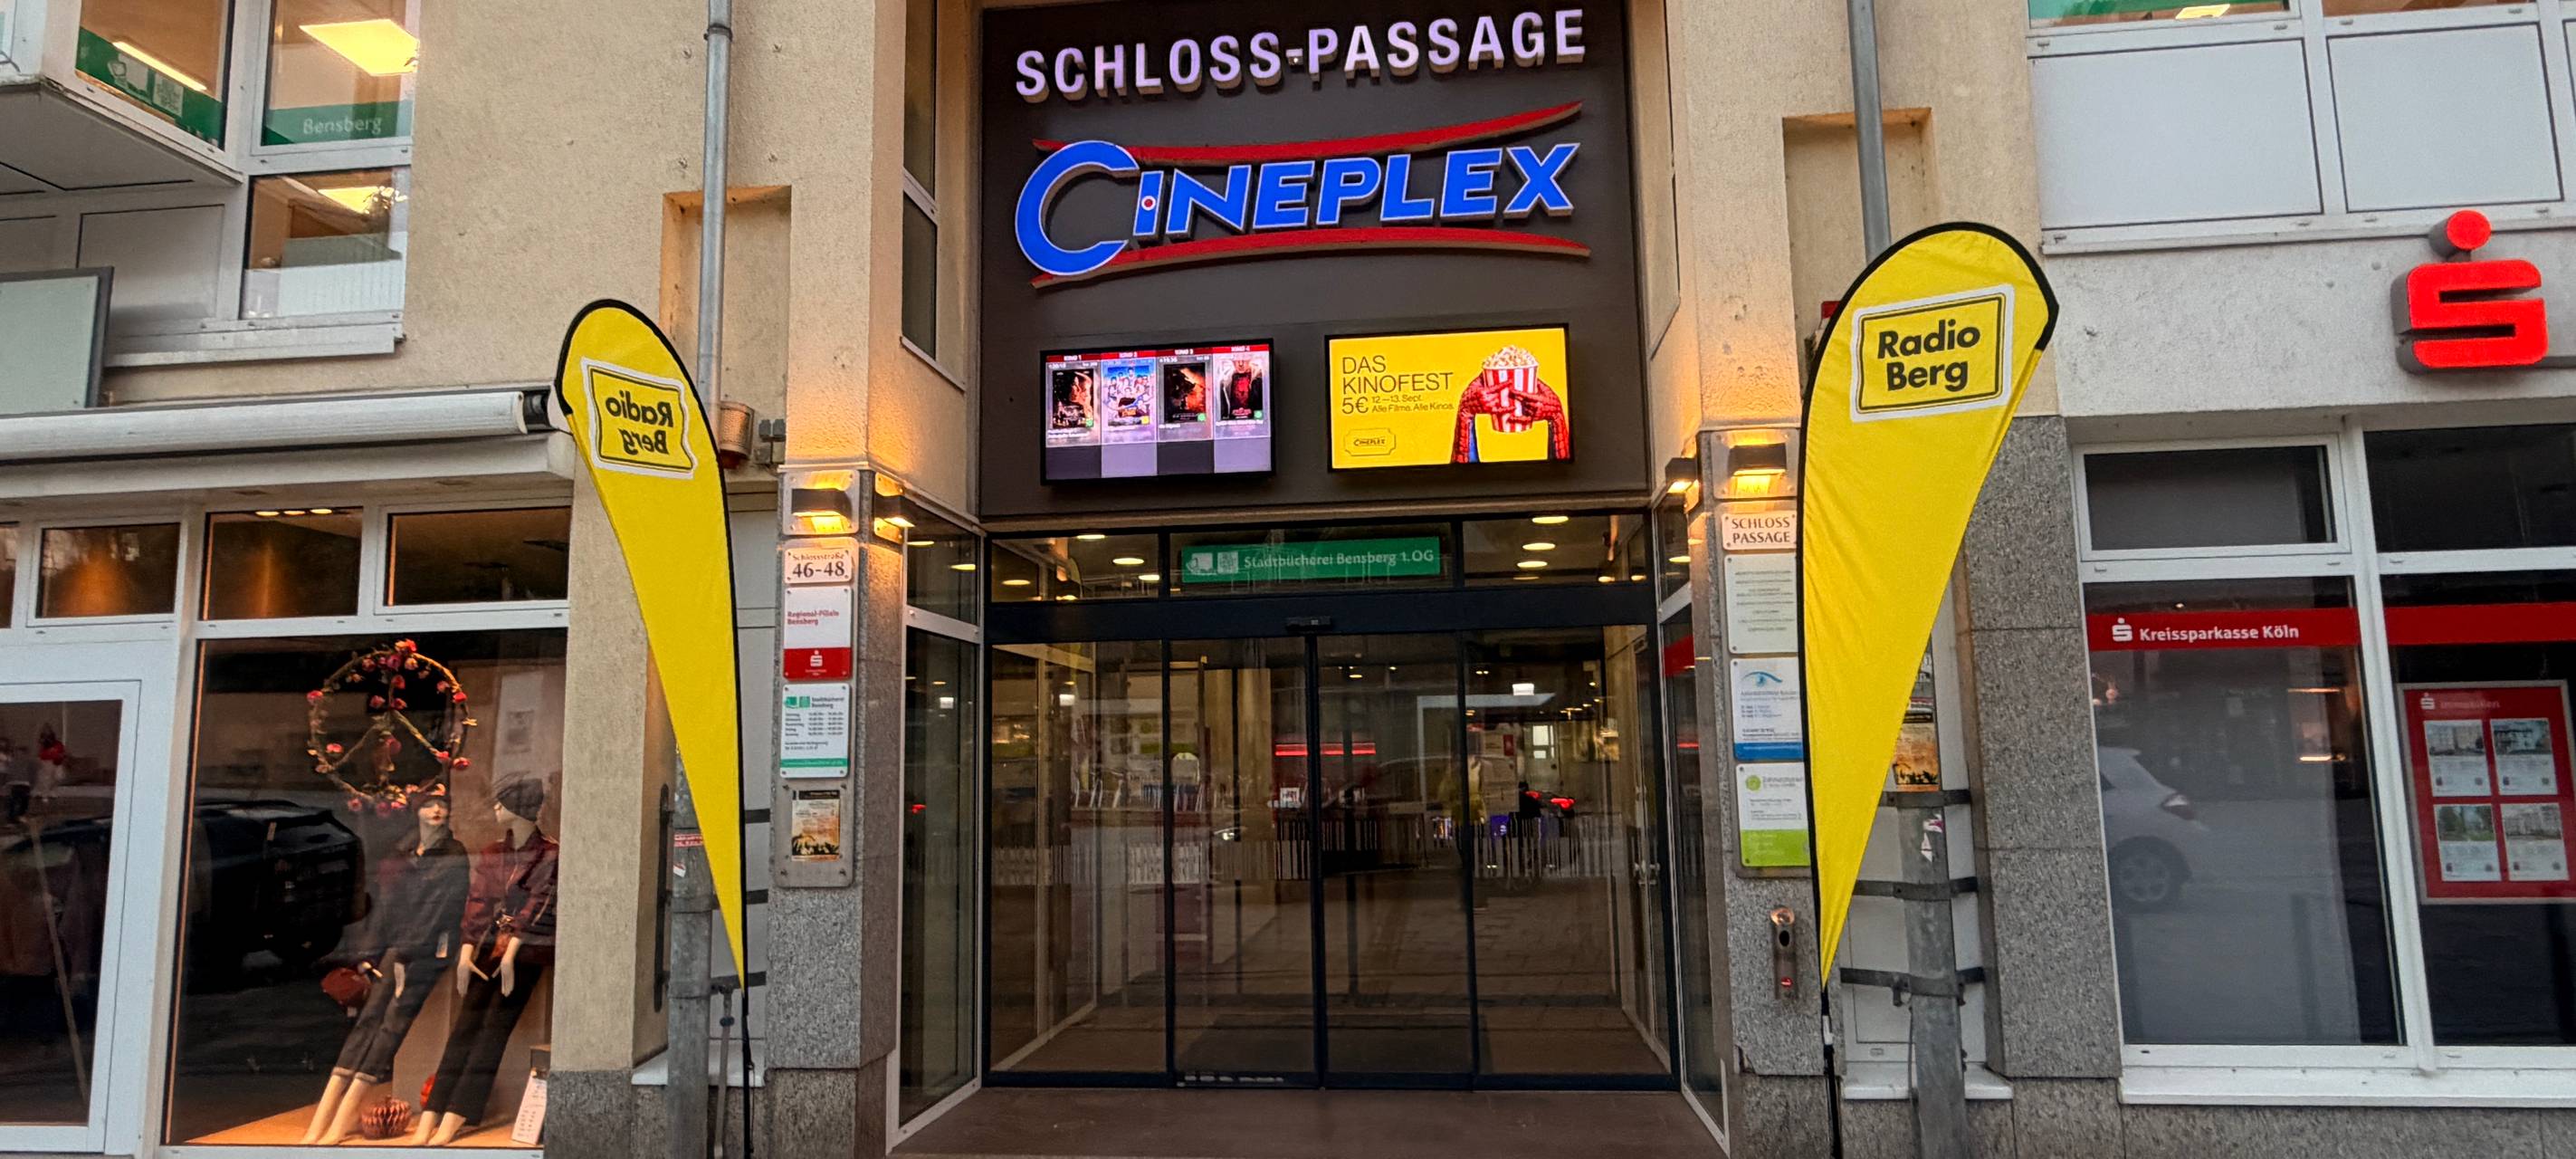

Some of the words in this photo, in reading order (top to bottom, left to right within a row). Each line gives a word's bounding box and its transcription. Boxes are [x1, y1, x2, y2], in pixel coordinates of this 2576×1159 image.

[1016, 8, 1586, 101] SCHLOSS-PASSAGE
[302, 117, 383, 135] Bensberg
[1877, 319, 1981, 359] Radio
[1342, 355, 1387, 374] DAS
[1342, 372, 1454, 395] KINOFEST
[1886, 361, 1970, 392] Berg
[1341, 396, 1369, 415] 5€
[1732, 516, 1790, 529] SCHLOSS
[1732, 531, 1791, 543] PASSAGE
[1244, 553, 1333, 569] Stadtbücherei
[1337, 551, 1398, 566] Bensberg
[2140, 626, 2259, 643] Kreissparkasse
[2262, 625, 2300, 639] Köln
